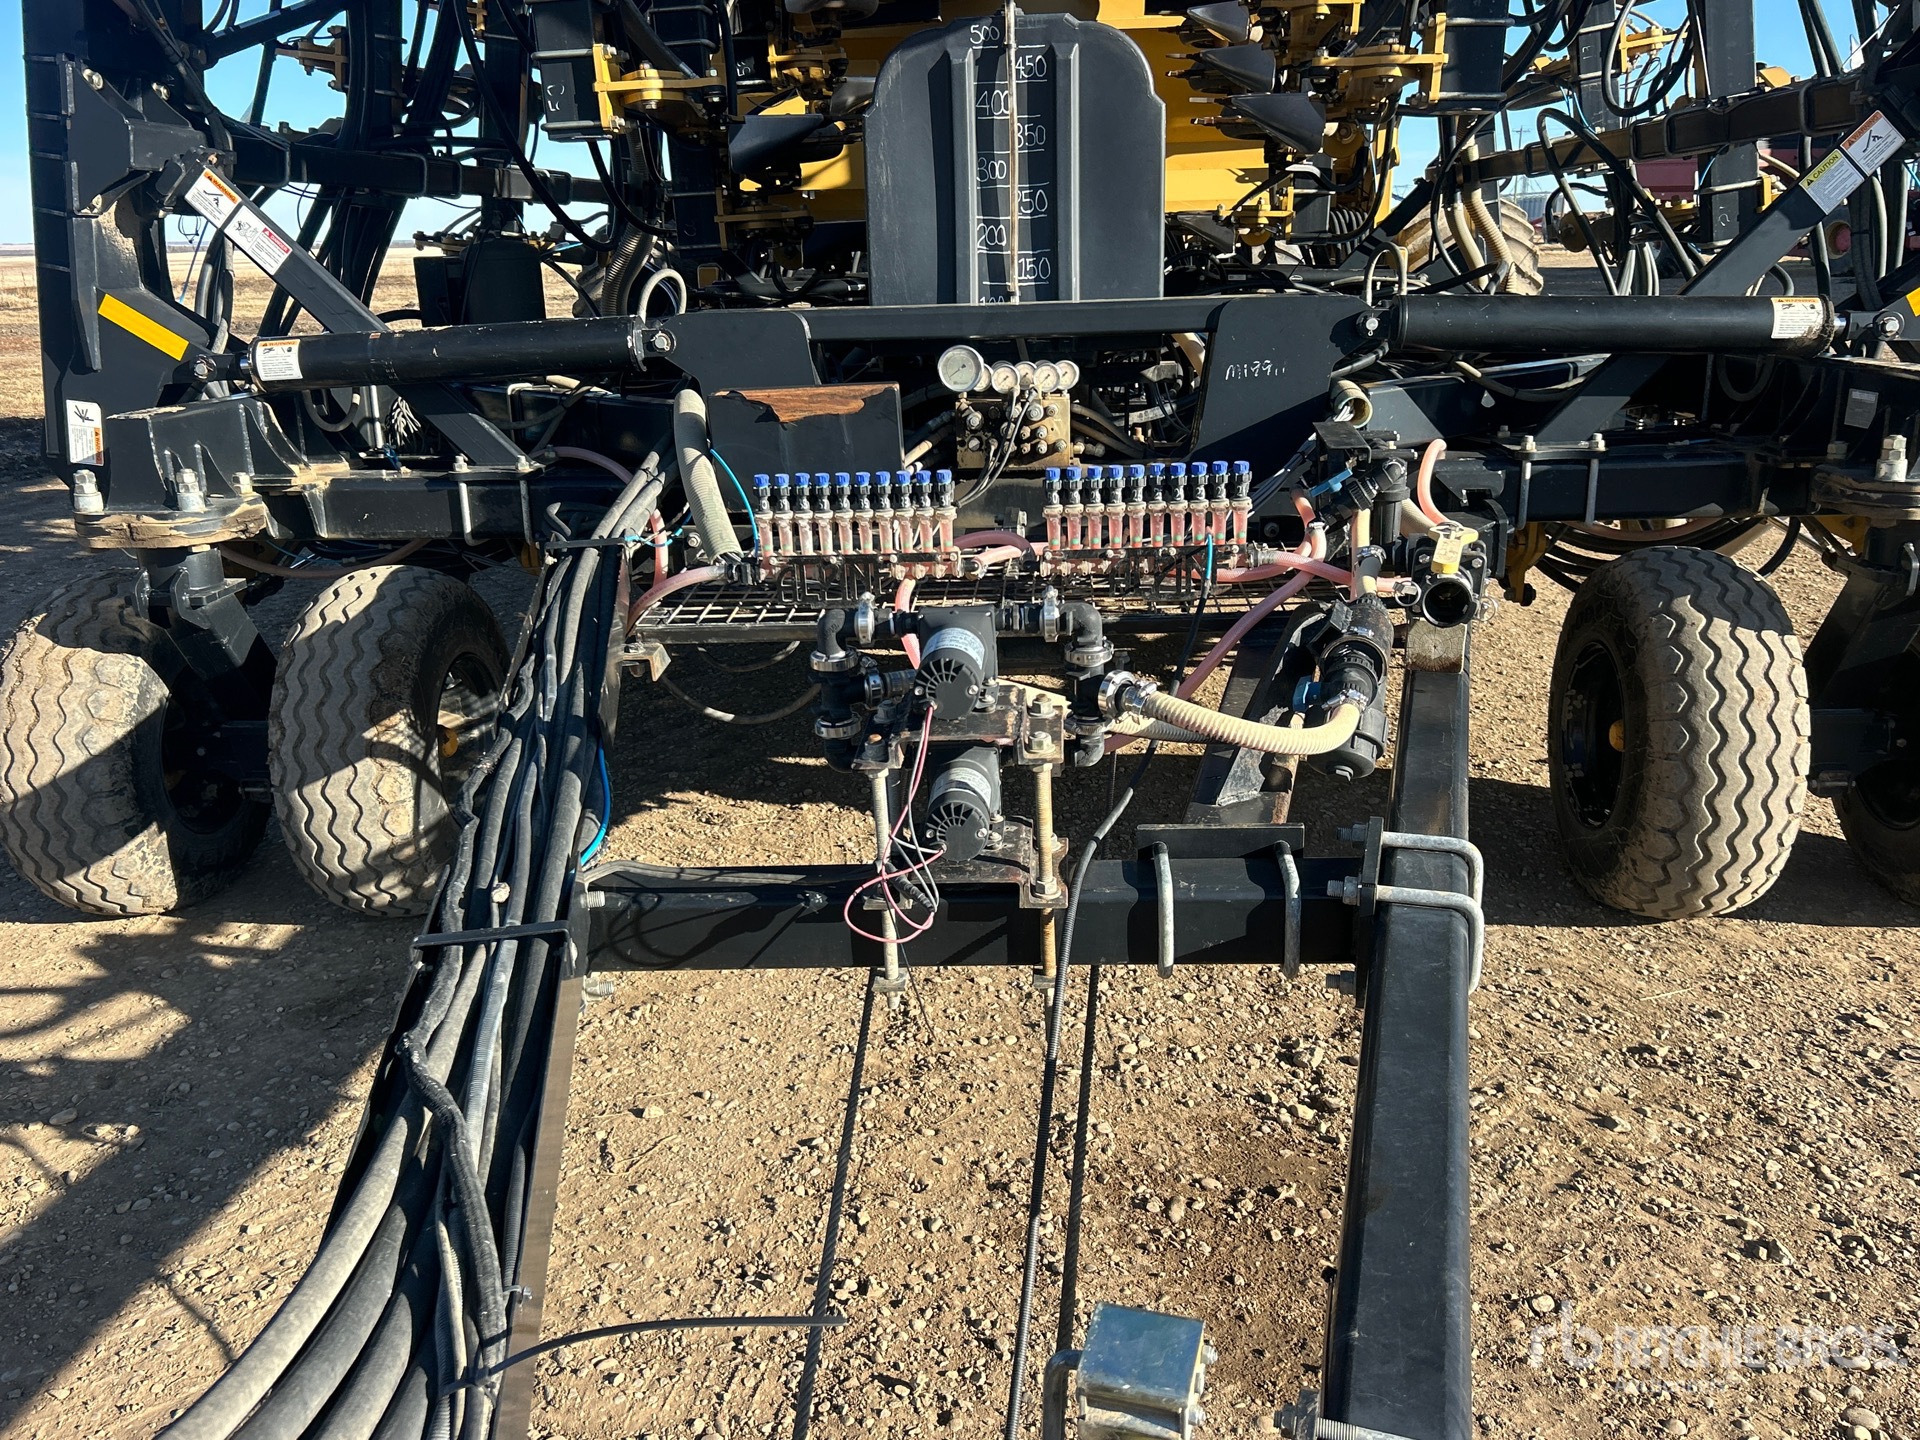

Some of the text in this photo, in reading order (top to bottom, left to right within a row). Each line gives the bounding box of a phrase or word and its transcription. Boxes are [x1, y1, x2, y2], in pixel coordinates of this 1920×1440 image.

[969, 24, 1000, 44] 500
[1015, 55, 1047, 79] 450
[975, 89, 1010, 115] 400
[976, 157, 1007, 182] 300
[1812, 153, 1839, 180] CAUTION
[212, 179, 237, 202] WARNING
[269, 235, 289, 253] DANGER
[976, 223, 1007, 250] 200
[1018, 257, 1051, 280] 150
